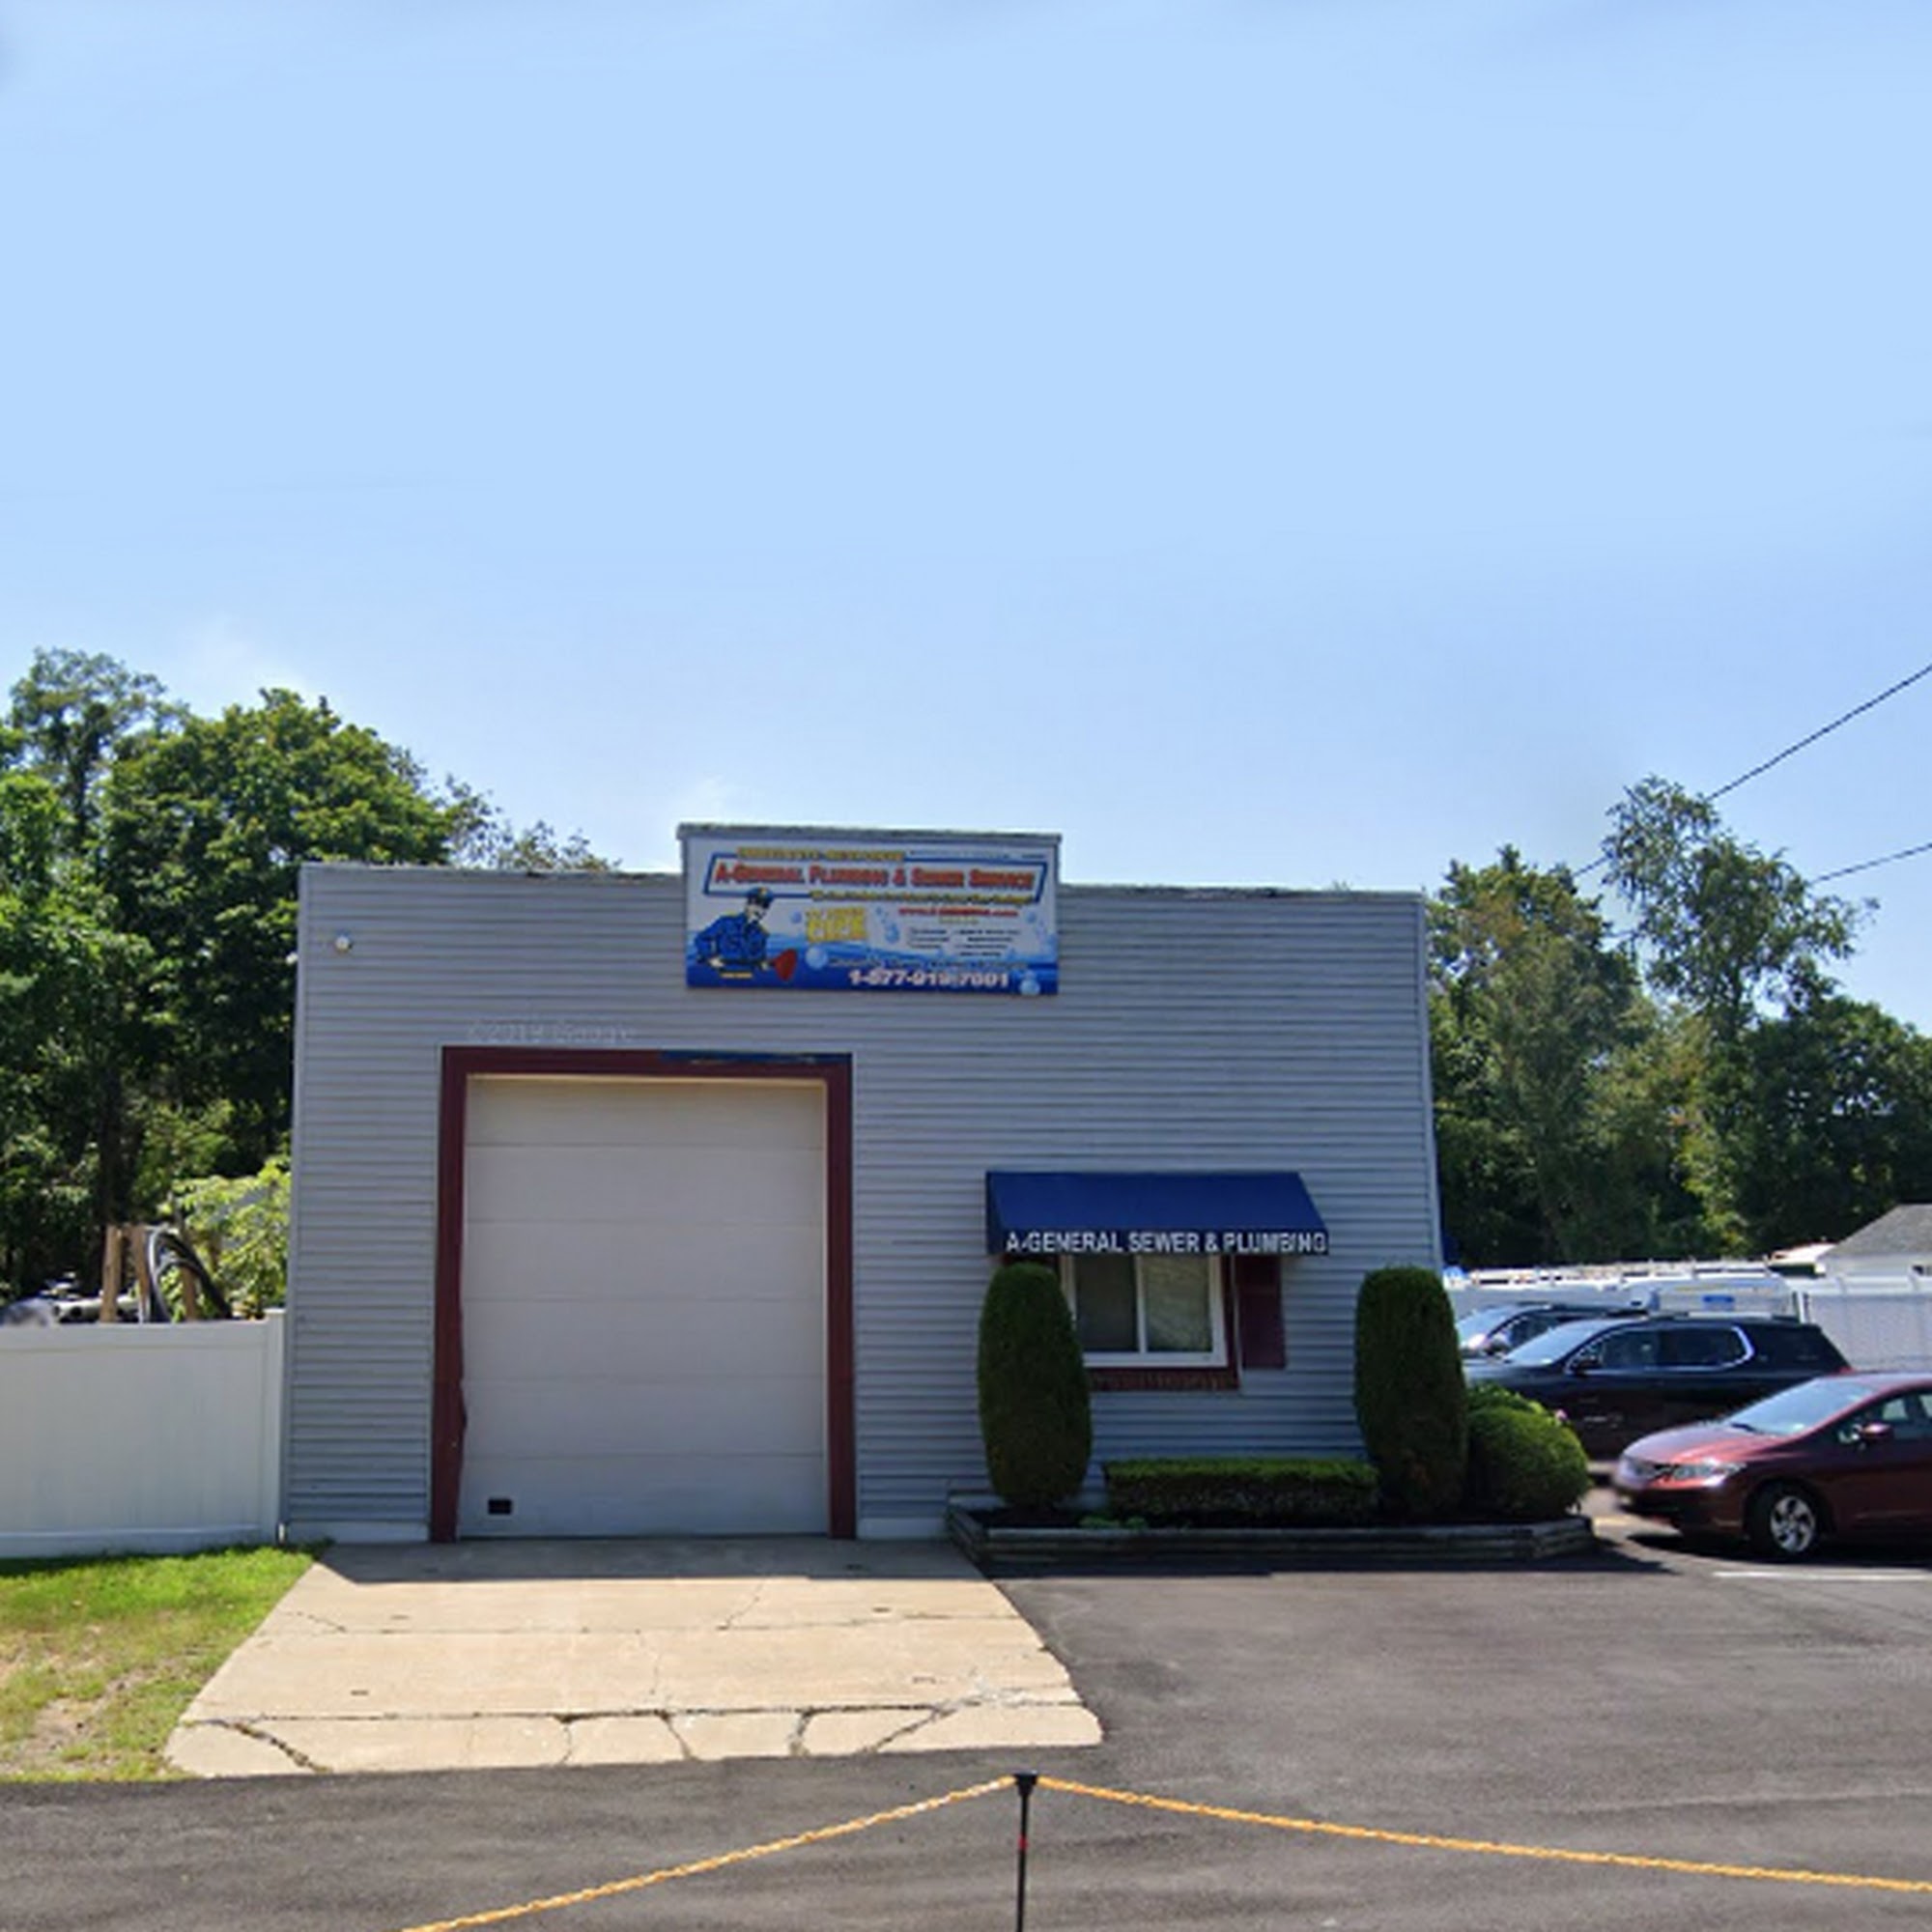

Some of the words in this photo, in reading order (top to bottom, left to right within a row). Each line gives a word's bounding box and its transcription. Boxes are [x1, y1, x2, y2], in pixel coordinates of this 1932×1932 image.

[1007, 1231, 1123, 1253] A-GENERAL
[1128, 1231, 1200, 1253] SEWER
[1205, 1231, 1218, 1253] &
[1223, 1231, 1326, 1254] PLUMBING
